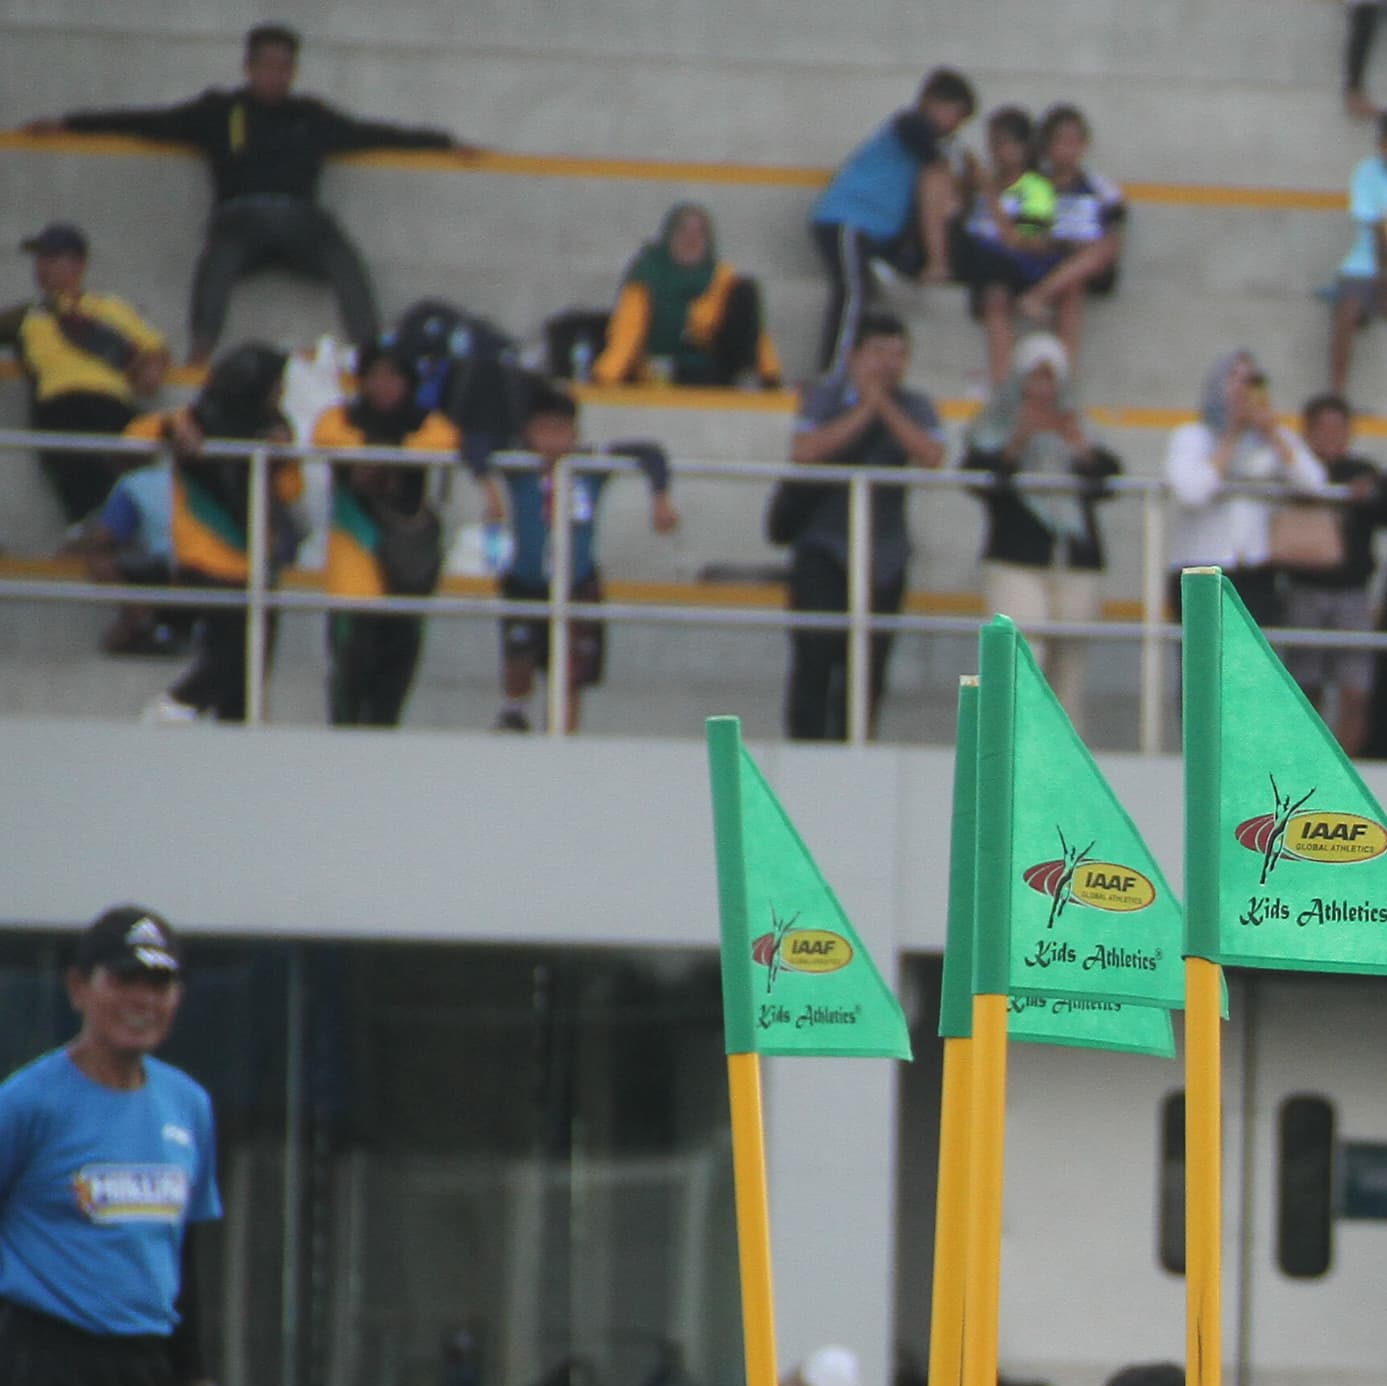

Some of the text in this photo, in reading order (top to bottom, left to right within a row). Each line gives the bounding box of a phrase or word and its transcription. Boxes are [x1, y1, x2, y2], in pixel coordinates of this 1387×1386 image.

[1300, 821, 1369, 841] IAAF
[1295, 843, 1375, 854] GLOBAL ATHLETICS
[1085, 871, 1137, 892] IAAF
[1239, 896, 1290, 926] Kids
[791, 939, 836, 955] IAAF
[1024, 940, 1077, 968] Kids
[757, 1004, 792, 1029] Kids
